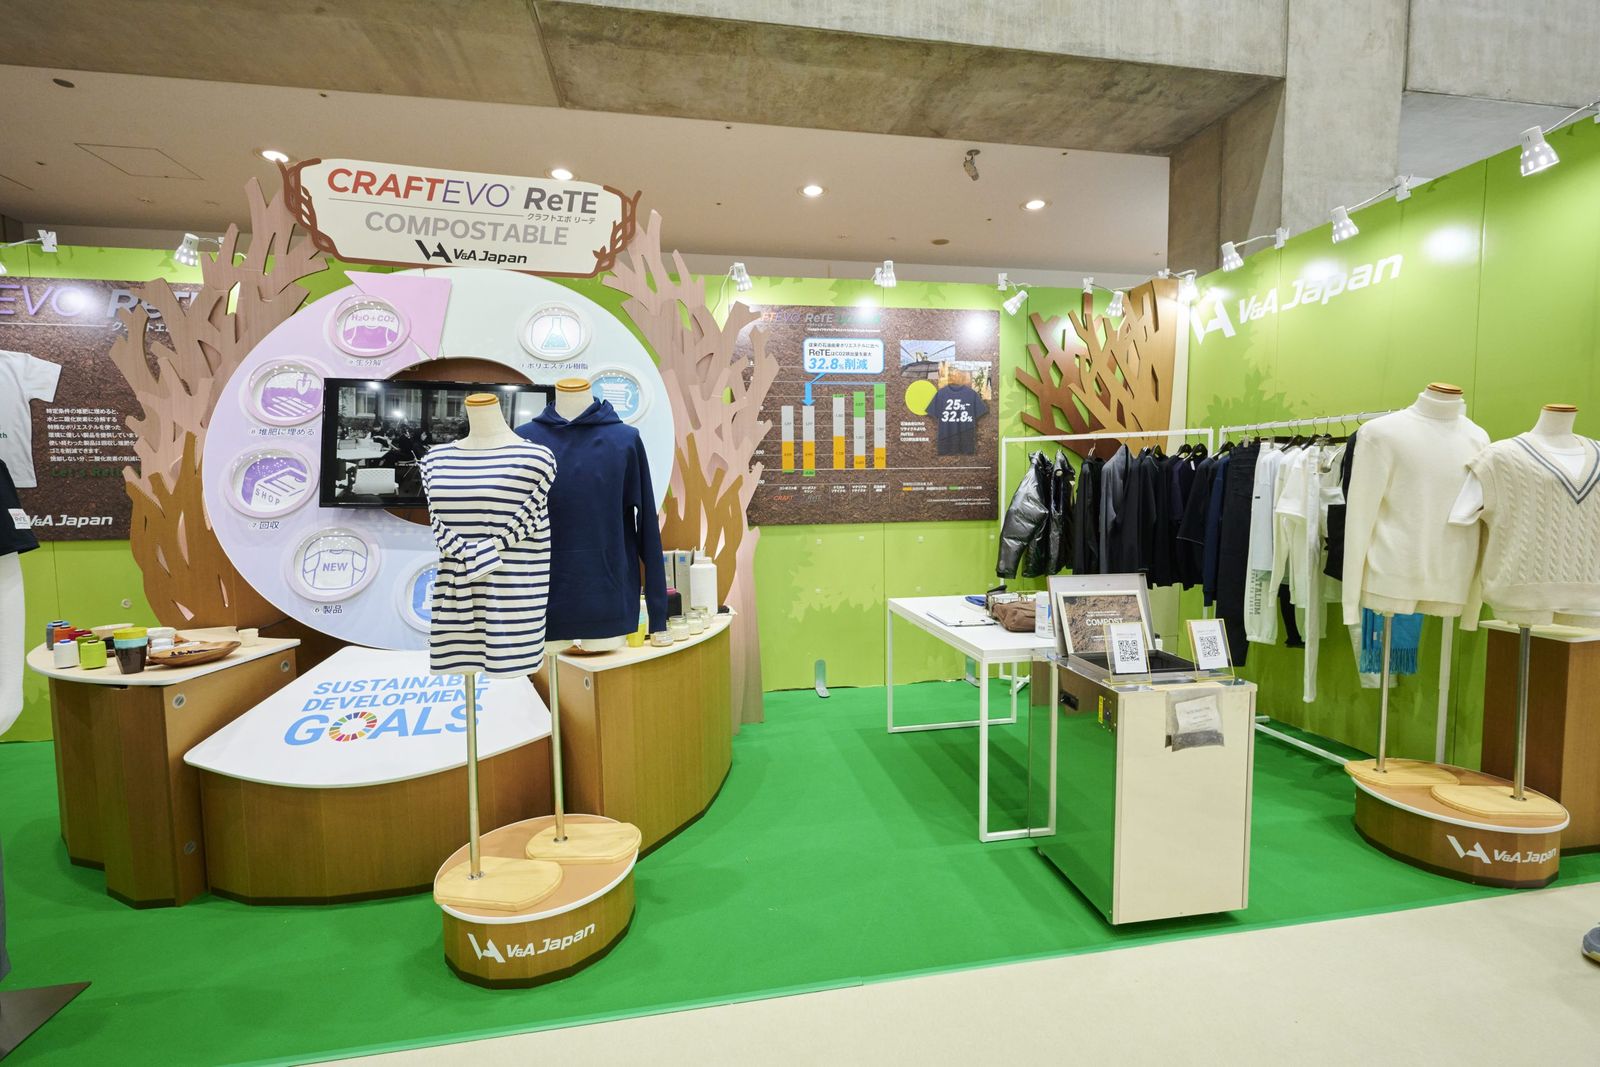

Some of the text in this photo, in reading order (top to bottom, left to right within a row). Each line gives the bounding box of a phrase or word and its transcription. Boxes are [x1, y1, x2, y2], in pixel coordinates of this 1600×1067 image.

[523, 186, 599, 215] ReTE
[365, 210, 569, 246] COMPOSTABLE
[453, 247, 478, 262] V&A
[478, 249, 528, 266] Japan
[1238, 286, 1279, 325] V&A
[1281, 253, 1404, 311] Japan
[805, 313, 834, 323] ReTE
[941, 411, 973, 423] 32.8%
[55, 514, 113, 529] Japan
[259, 520, 280, 529] 回収
[322, 562, 348, 572] NEW
[323, 604, 343, 615] 製品
[1086, 617, 1124, 626] COMPOST
[313, 672, 491, 695] SUSTAINABE
[1493, 848, 1521, 864] V&A
[1522, 847, 1557, 864] Japan
[506, 942, 535, 958] V&A
[537, 923, 596, 954] Japan
